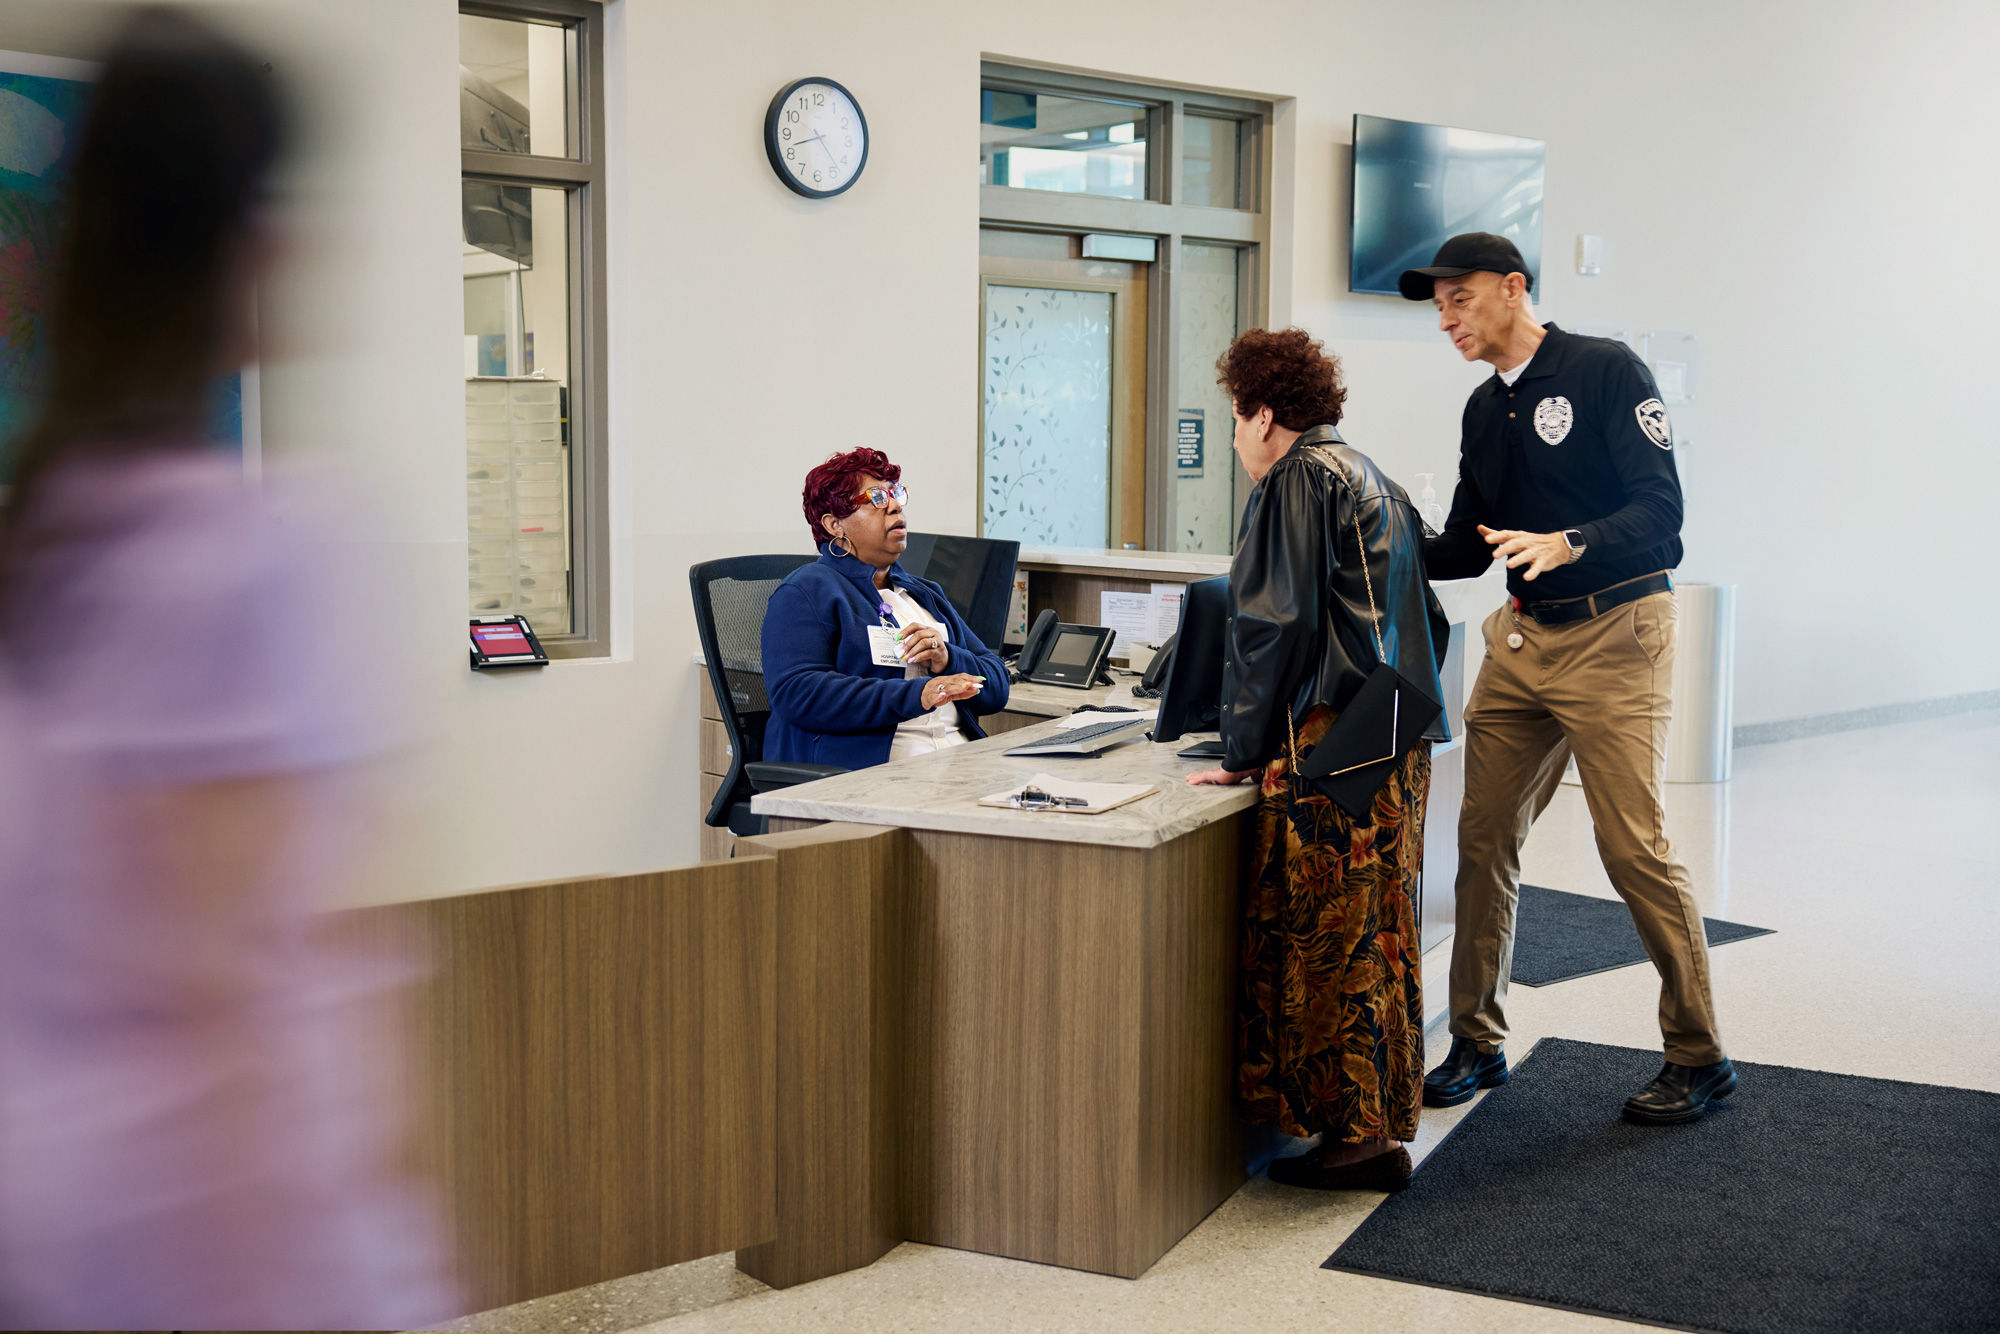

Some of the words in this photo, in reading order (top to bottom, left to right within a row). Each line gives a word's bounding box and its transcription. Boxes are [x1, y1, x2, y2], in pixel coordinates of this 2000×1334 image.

[799, 97, 808, 110] 11
[812, 93, 825, 106] 12
[786, 110, 800, 123] 10
[840, 117, 849, 130] 2
[782, 127, 792, 141] 9
[844, 135, 853, 148] 3
[786, 147, 796, 160] 8
[840, 154, 848, 167] 4
[798, 162, 806, 176] 7
[828, 166, 838, 179] 5
[813, 169, 823, 183] 6
